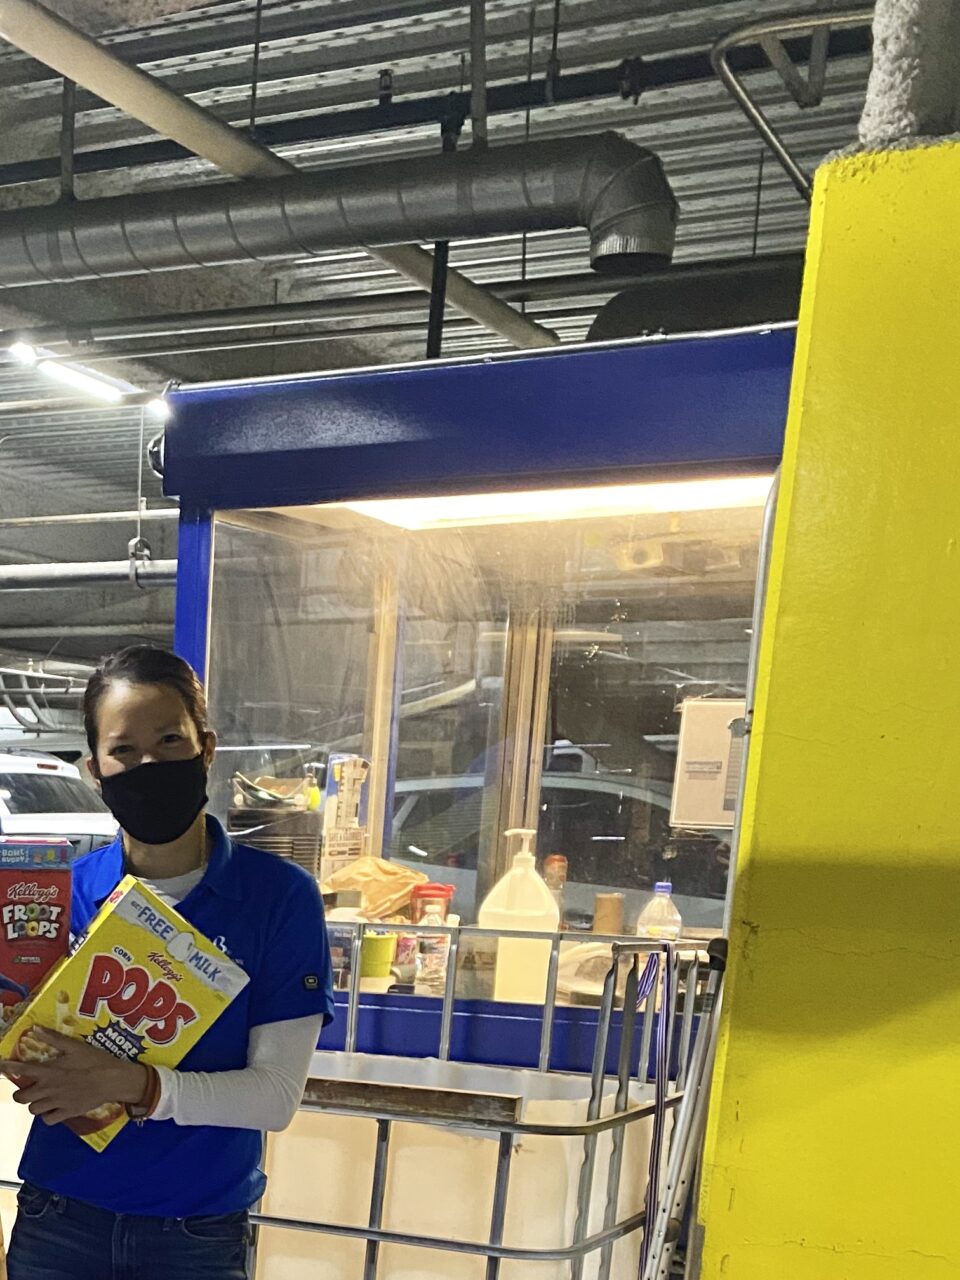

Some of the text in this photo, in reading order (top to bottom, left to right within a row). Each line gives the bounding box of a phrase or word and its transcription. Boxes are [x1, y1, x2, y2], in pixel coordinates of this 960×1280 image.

[7, 882, 59, 903] Kellogg's
[2, 902, 62, 925] FROOT
[7, 920, 61, 940] LOOPS
[113, 945, 133, 962] CORN
[139, 905, 174, 940] FREE
[189, 951, 223, 983] MILK
[147, 951, 184, 982] Kellogg's
[78, 953, 199, 1046] POPS
[105, 1027, 139, 1057] MORE
